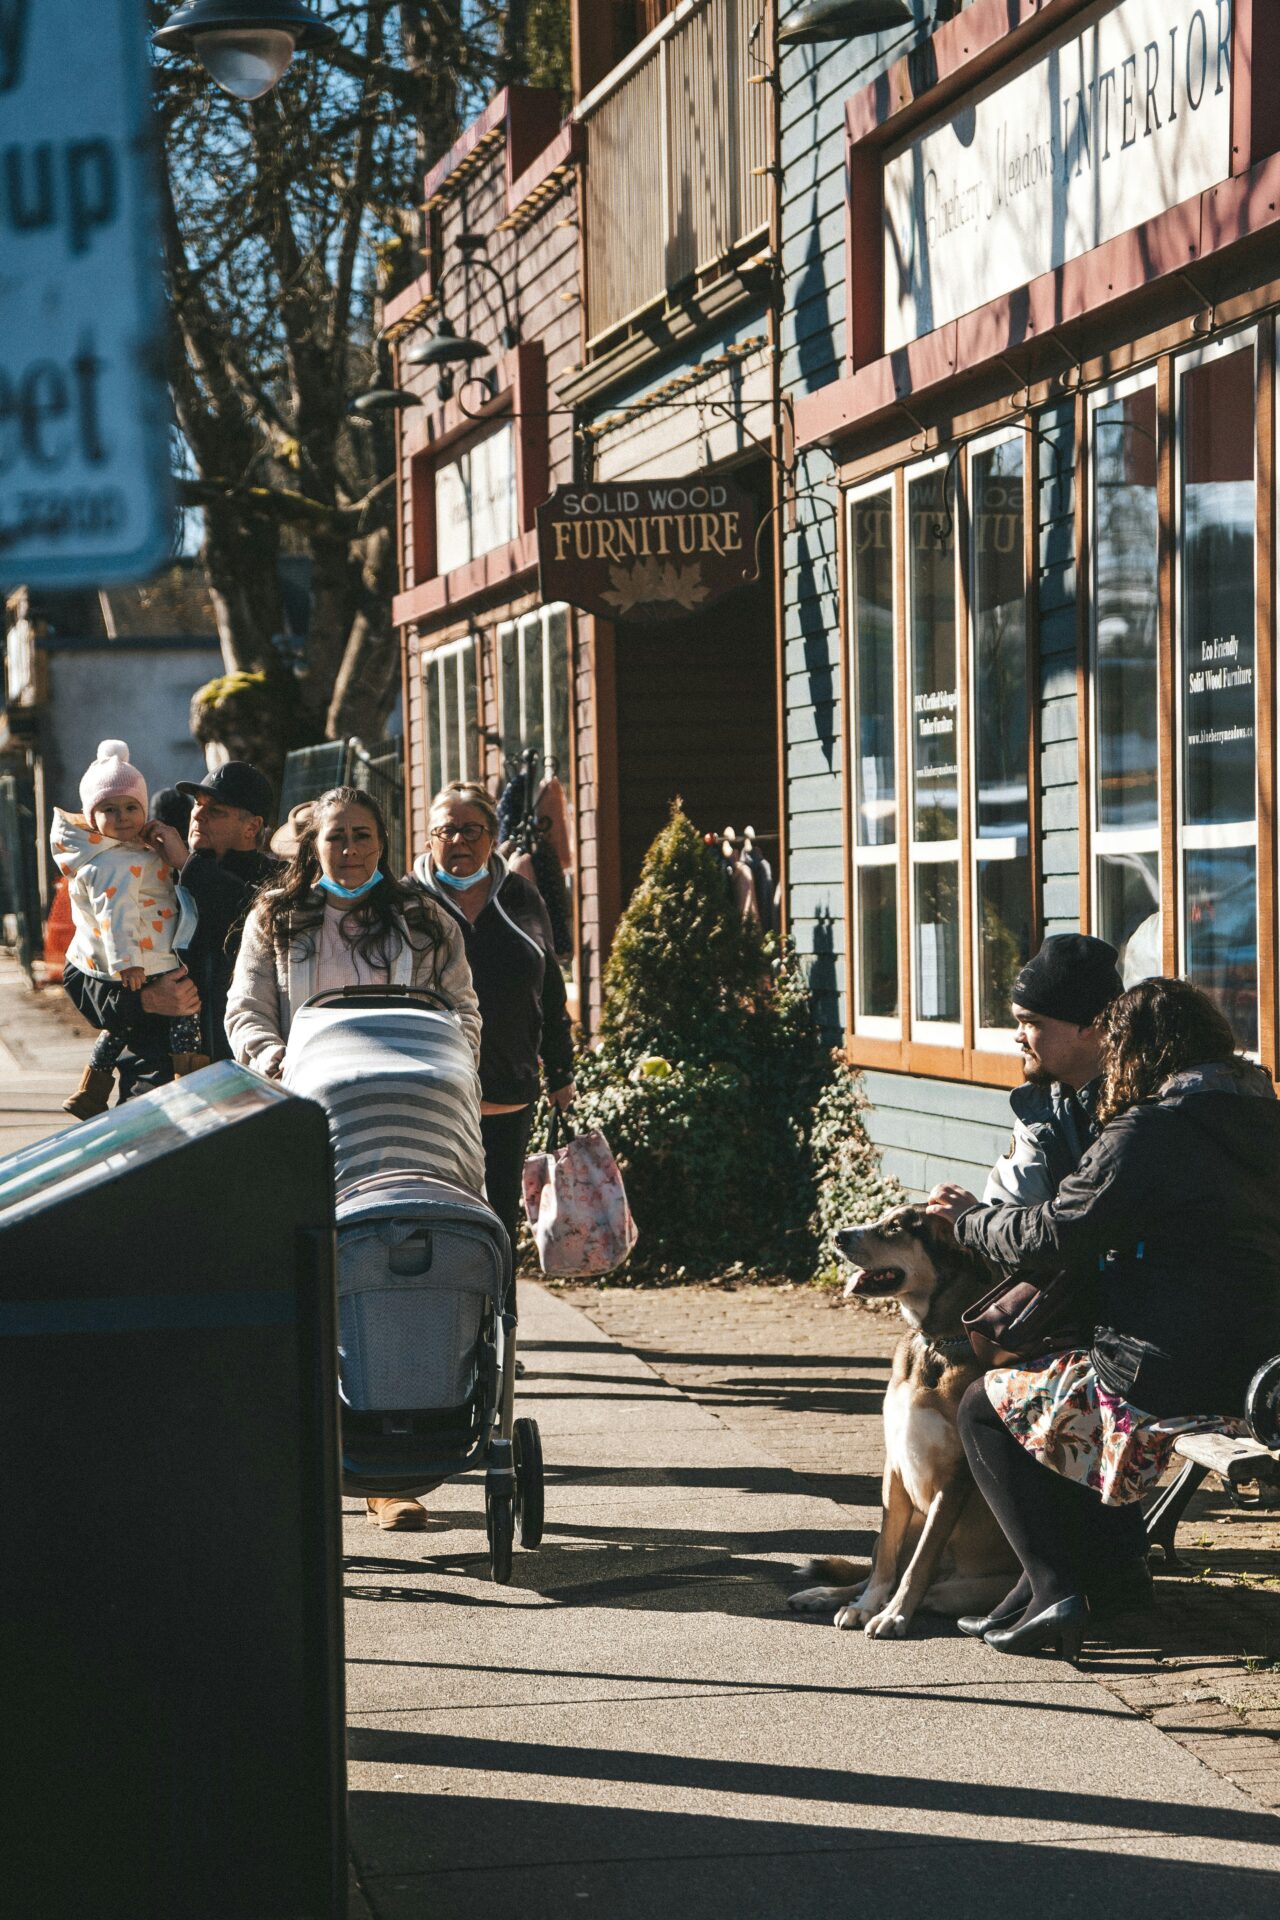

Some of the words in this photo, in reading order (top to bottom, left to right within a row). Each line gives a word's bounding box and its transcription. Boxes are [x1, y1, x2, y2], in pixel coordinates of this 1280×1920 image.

[563, 490, 640, 515] SOLID
[648, 486, 727, 510] WOOD
[551, 511, 742, 563] FURNITURE
[1201, 640, 1214, 661] Eco
[1189, 671, 1205, 694] Solid
[1204, 667, 1222, 690] Wood
[1222, 664, 1252, 688] Furniture
